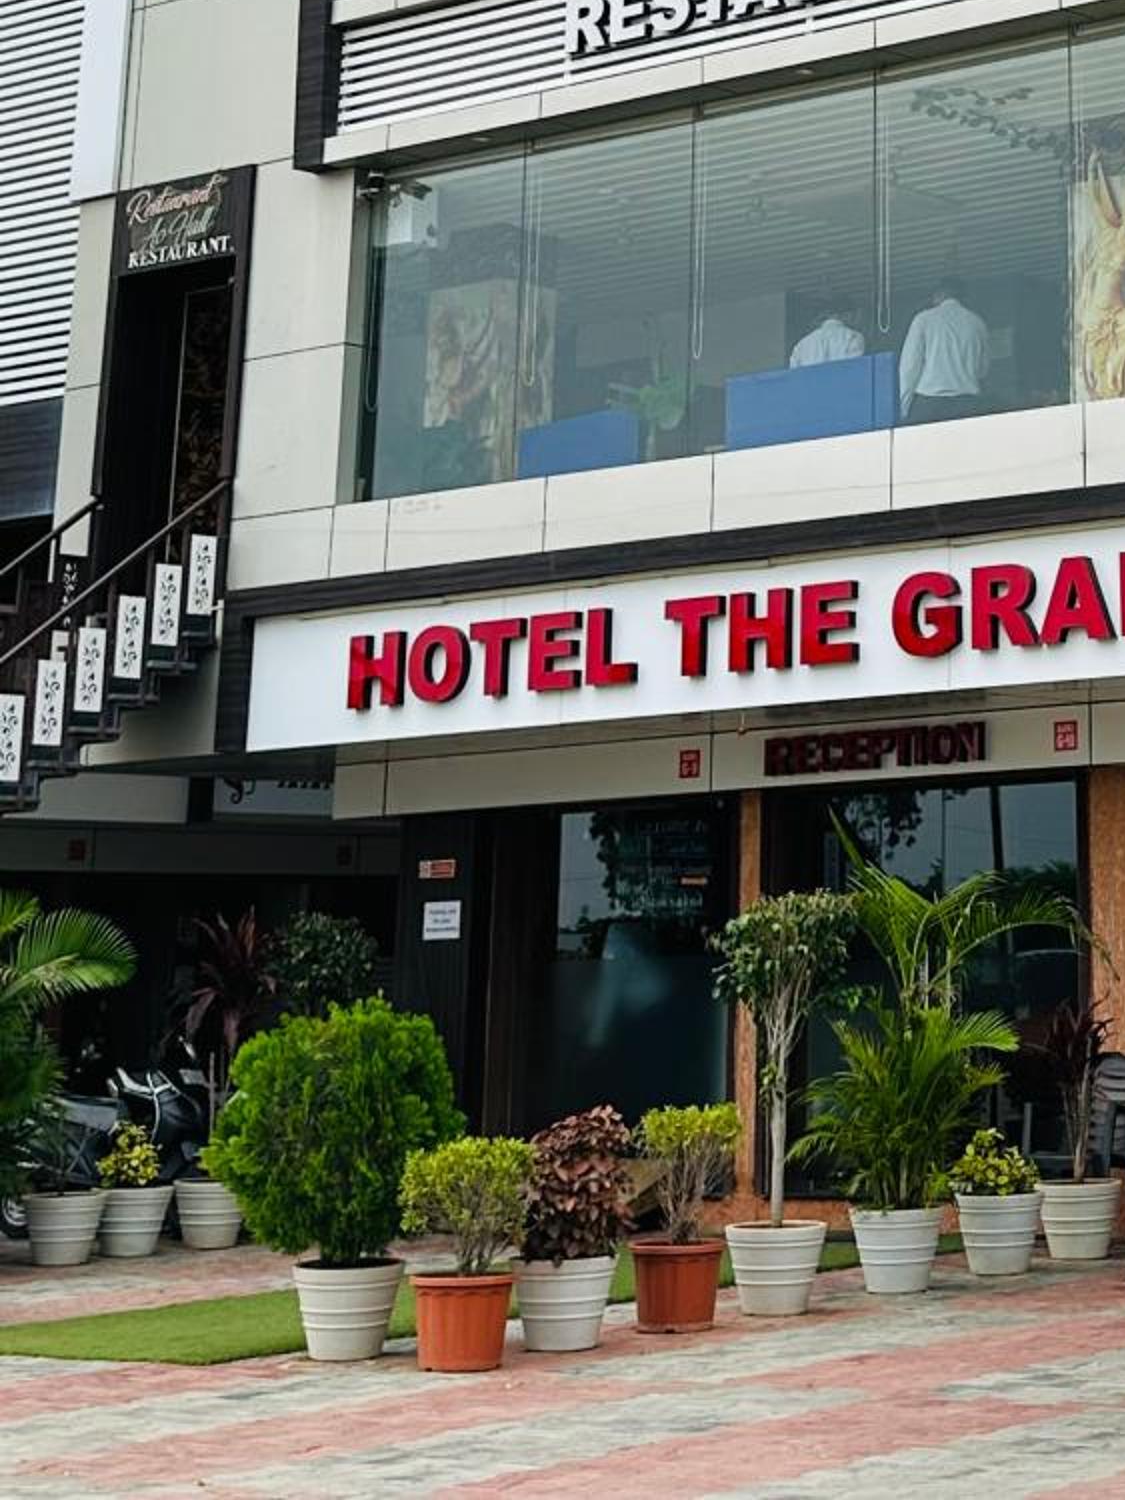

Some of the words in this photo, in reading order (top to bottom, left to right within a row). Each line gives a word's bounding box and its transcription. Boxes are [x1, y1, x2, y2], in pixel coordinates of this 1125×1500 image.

[347, 607, 639, 711] HOTEL
[664, 580, 859, 678] THE
[764, 722, 986, 776] RECEPTION
